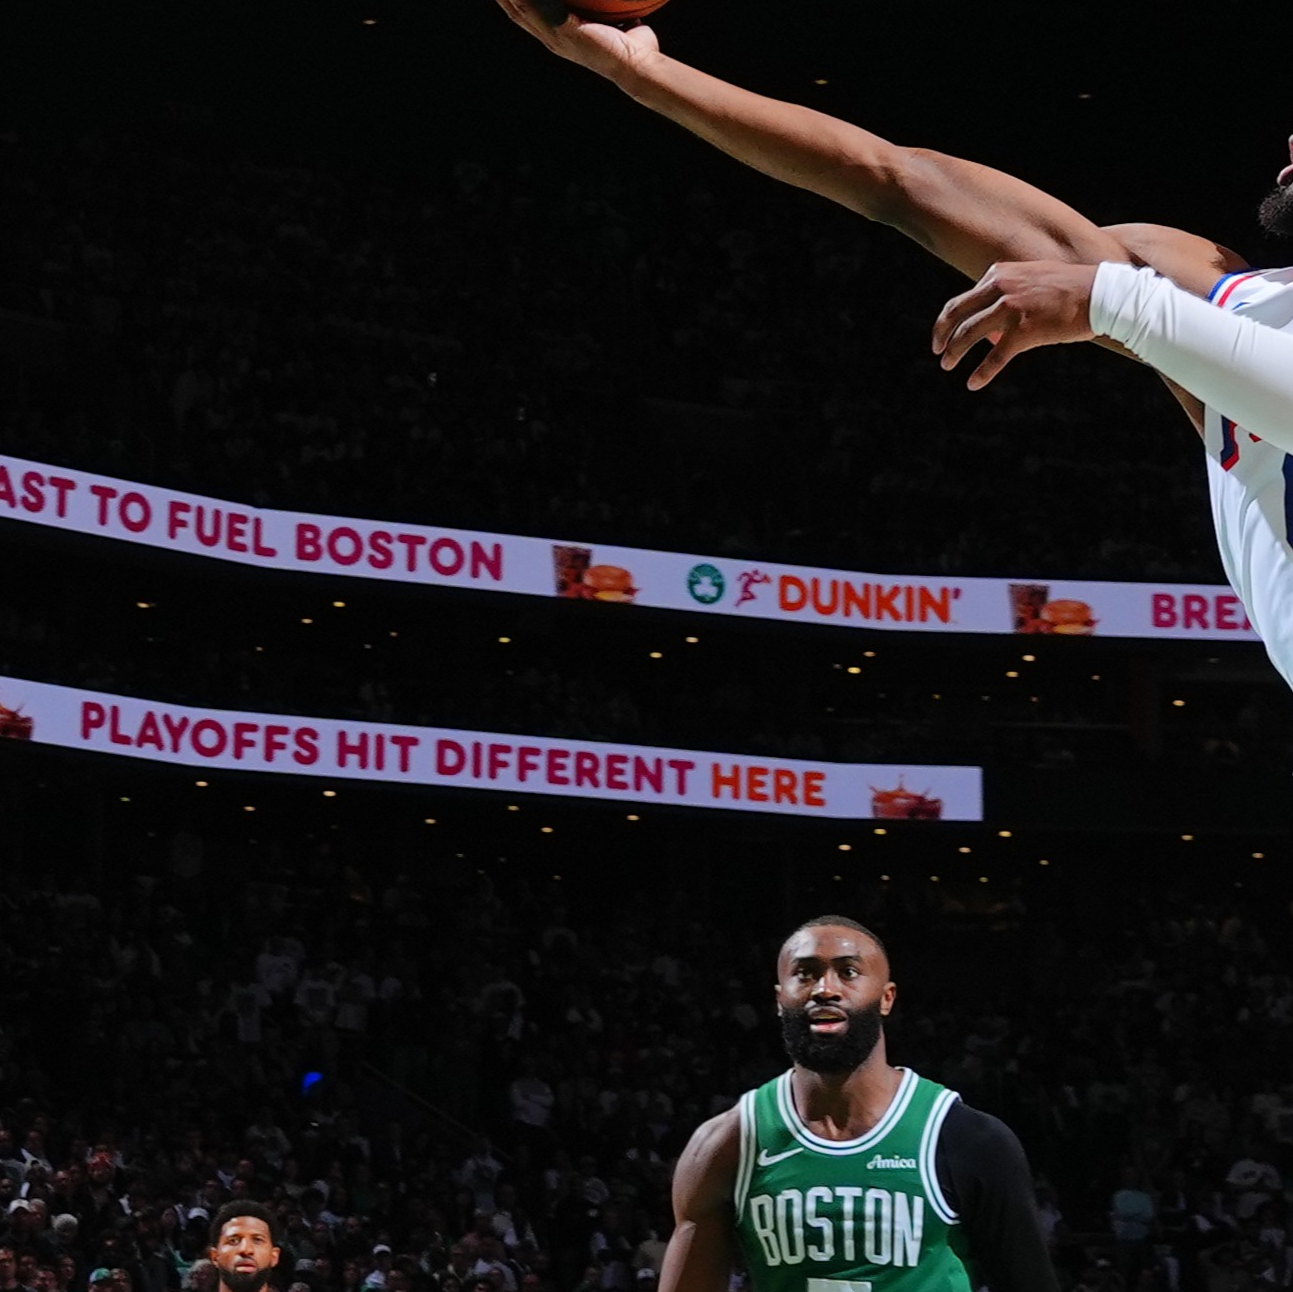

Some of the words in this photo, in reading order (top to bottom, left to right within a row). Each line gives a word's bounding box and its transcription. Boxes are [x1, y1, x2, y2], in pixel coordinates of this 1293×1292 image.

[90, 484, 152, 534] TO
[167, 500, 277, 558] FUEL
[294, 523, 503, 581] BOSTON
[80, 700, 320, 766] PLAYOFFS
[335, 729, 420, 774] HIT
[435, 738, 695, 796] DIFFERENT
[712, 762, 827, 808] HERE
[867, 1155, 916, 1170] Amica
[750, 1187, 924, 1267] BOSTON
